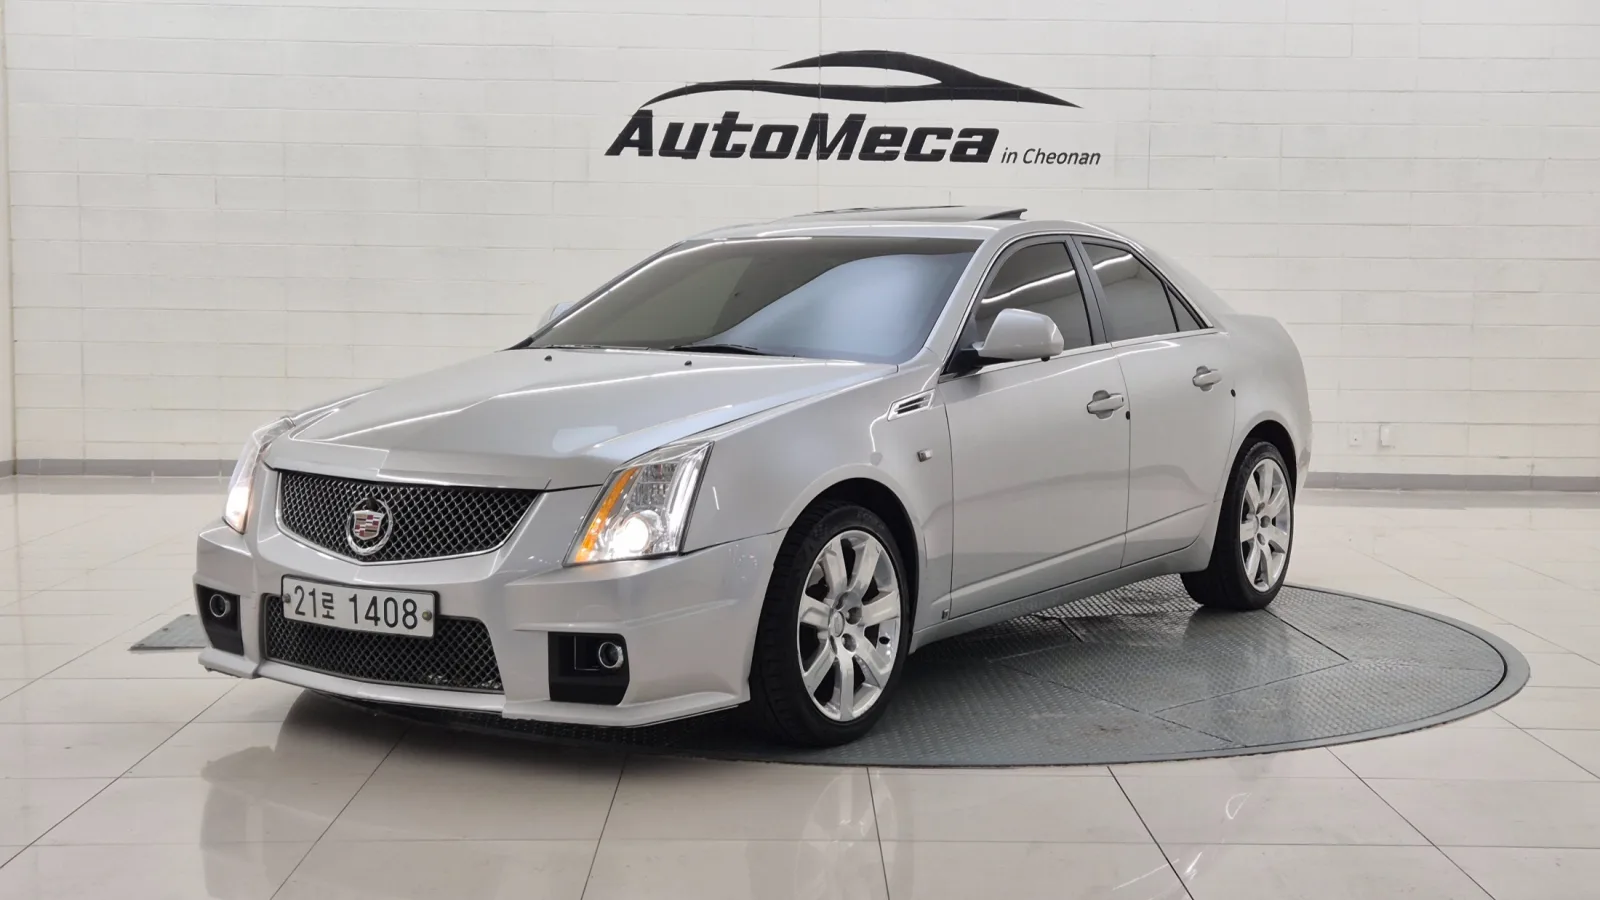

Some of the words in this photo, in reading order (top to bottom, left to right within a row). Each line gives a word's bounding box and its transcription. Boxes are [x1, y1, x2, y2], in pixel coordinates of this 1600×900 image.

[604, 109, 999, 163] AutoMeca
[1001, 147, 1018, 164] in
[1023, 148, 1101, 165] Cheonan
[294, 585, 335, 620] 21로
[349, 594, 418, 630] 1408
